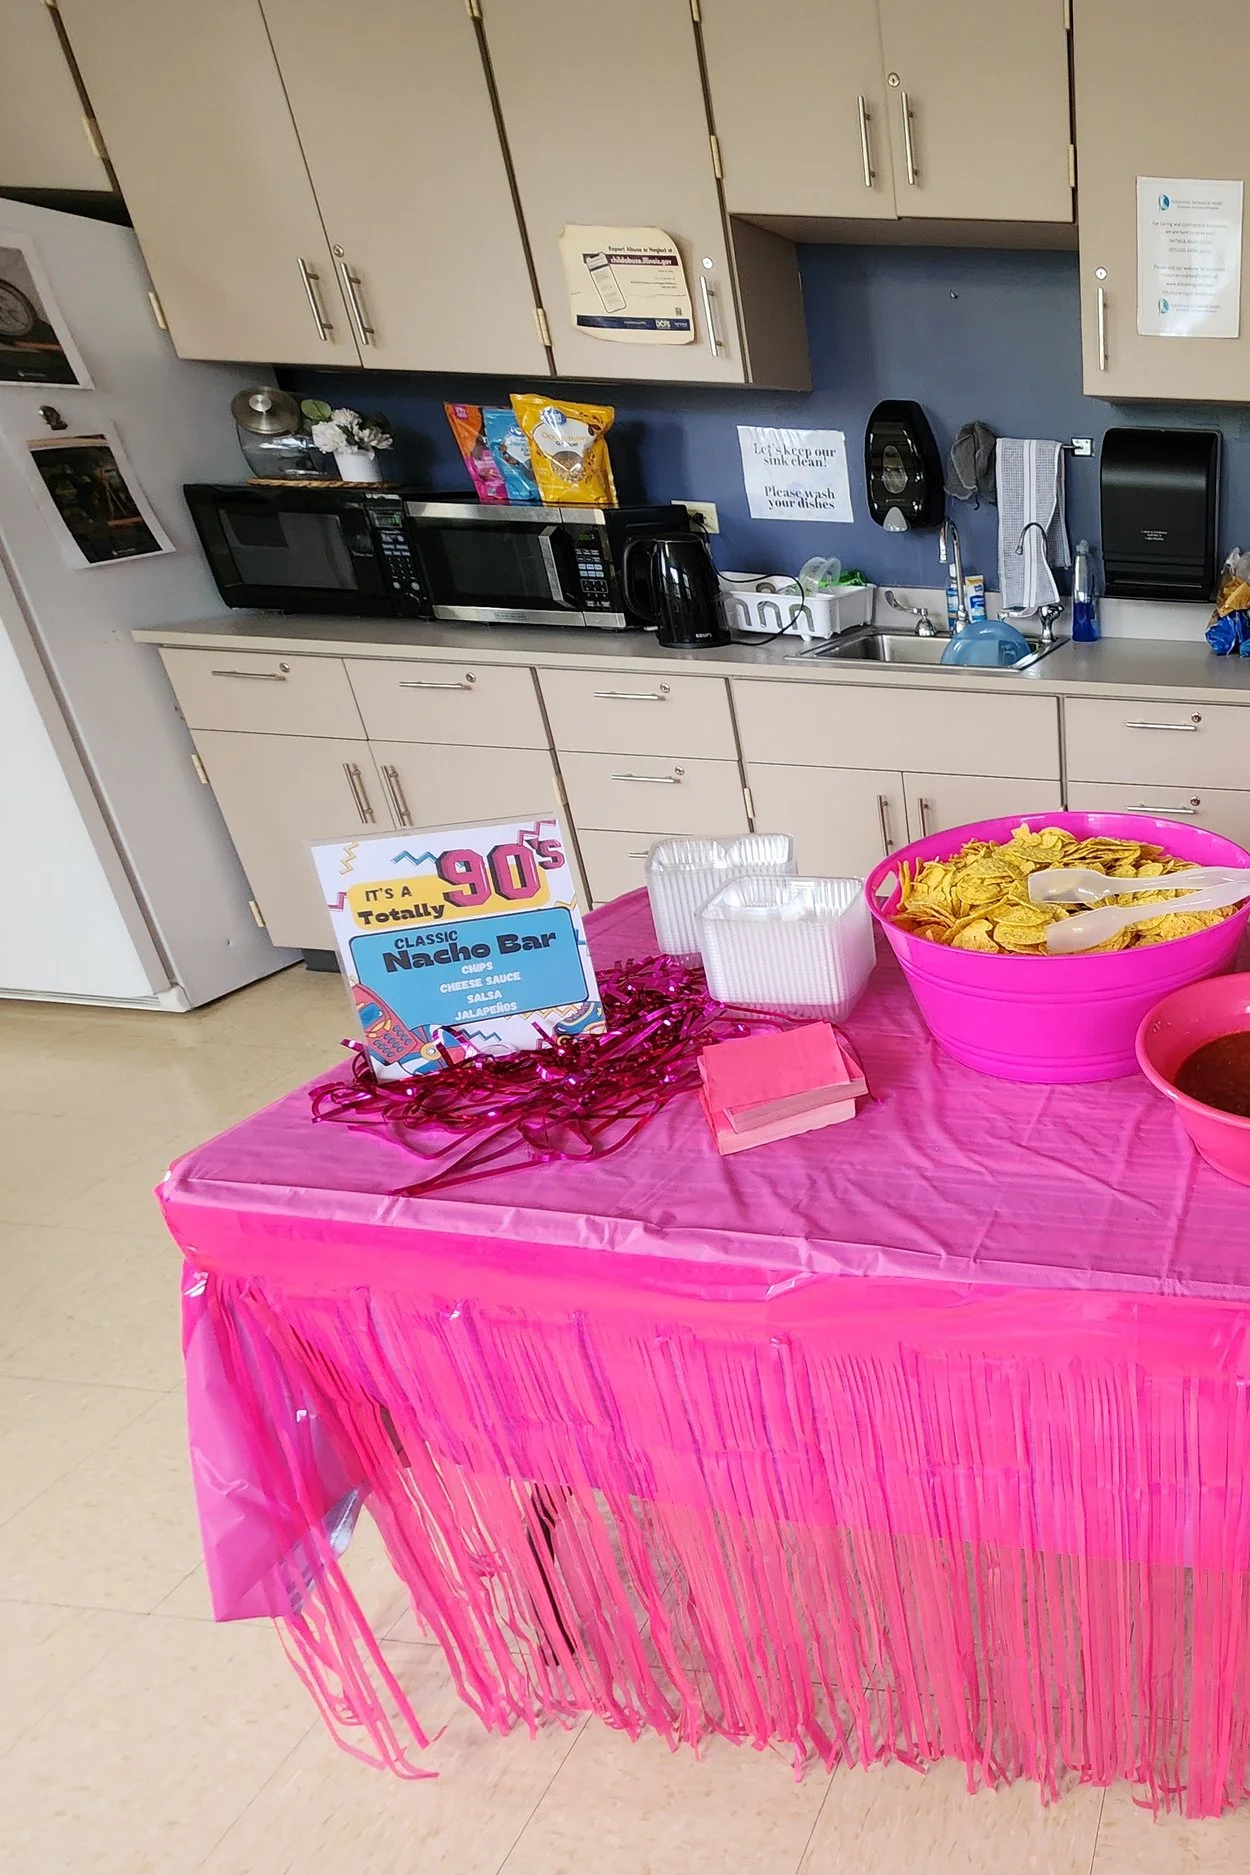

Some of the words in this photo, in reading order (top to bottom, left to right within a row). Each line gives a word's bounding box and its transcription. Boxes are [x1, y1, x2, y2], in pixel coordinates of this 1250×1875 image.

[753, 443, 781, 456] Let's
[783, 444, 812, 459] keep
[814, 448, 836, 457] our
[763, 454, 789, 466] sink
[791, 455, 827, 468] clean!
[764, 485, 802, 498] Please
[803, 487, 835, 499] wash
[768, 499, 796, 510] your
[797, 497, 836, 509] dishes
[365, 887, 394, 902] IT'S
[401, 886, 412, 898] A
[357, 903, 445, 925] Totally
[394, 930, 458, 950] CLASSIC
[382, 942, 491, 973] Nacho
[496, 932, 557, 954] Bar
[461, 962, 494, 975] CHIPS
[439, 978, 483, 993] CHEESE
[485, 971, 521, 985] SAUCE
[466, 989, 502, 1004] SALSA
[454, 1001, 517, 1022] JALAPEÑOS
